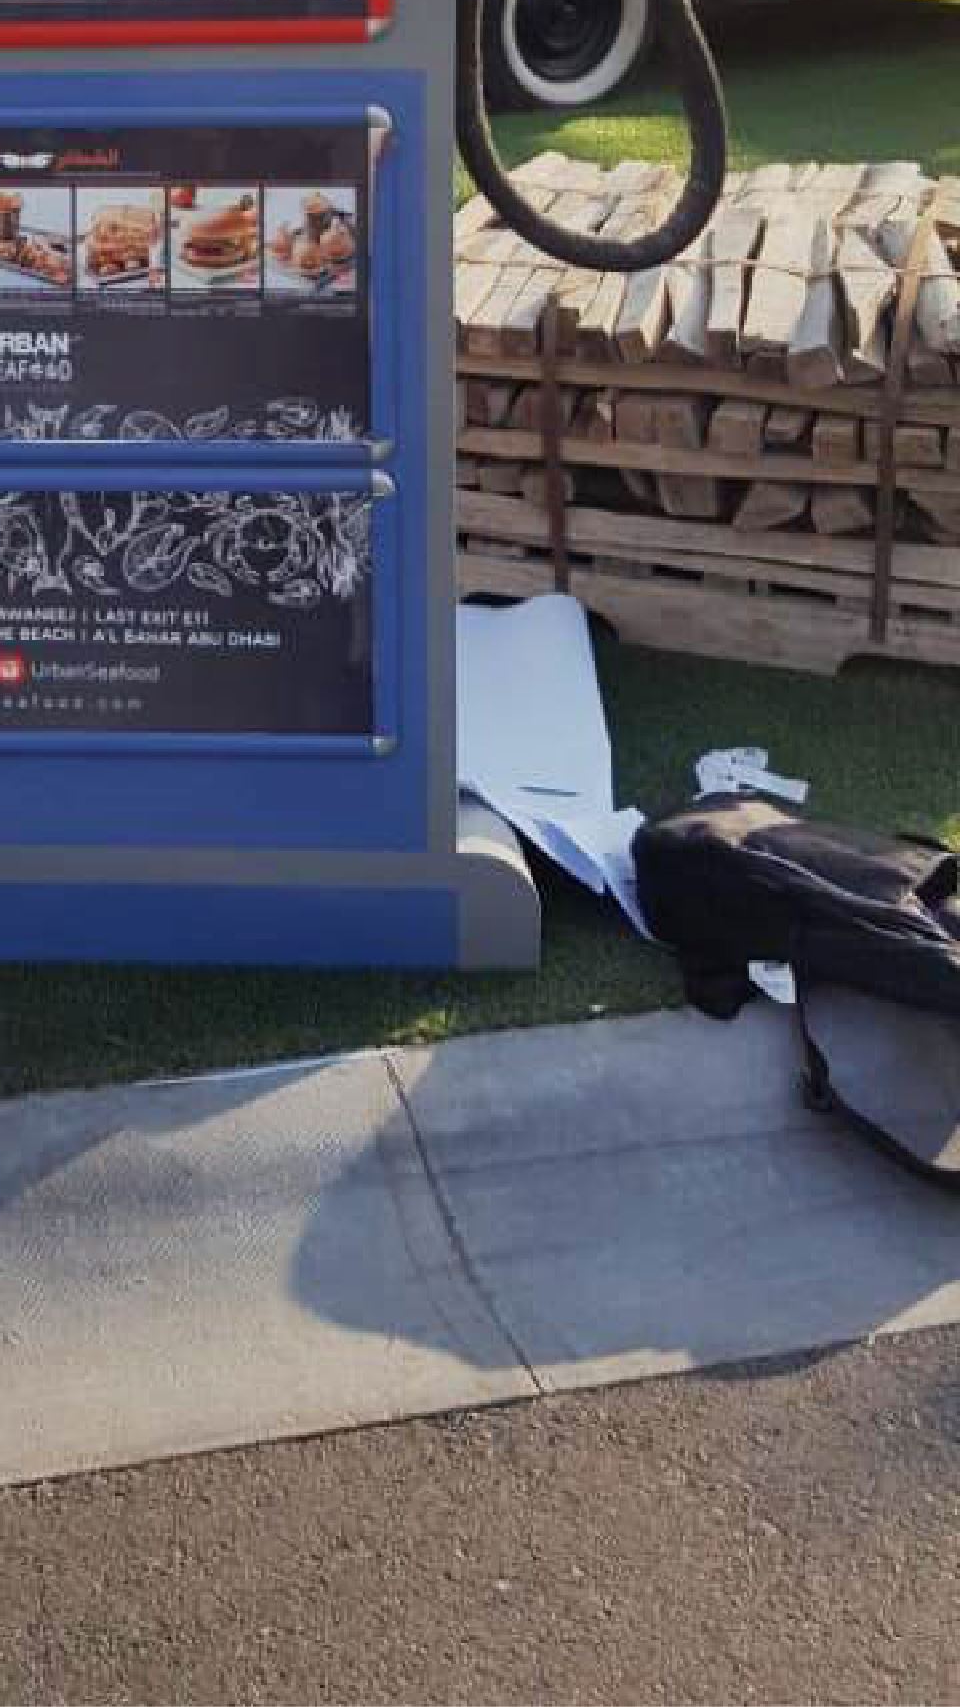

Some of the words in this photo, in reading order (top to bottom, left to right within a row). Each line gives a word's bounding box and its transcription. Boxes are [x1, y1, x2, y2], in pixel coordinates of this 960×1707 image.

[95, 607, 135, 624] LAST
[141, 609, 178, 625] EXIT
[20, 626, 76, 642] BEACH
[188, 631, 225, 646] ABU
[227, 631, 281, 647] DHABI
[31, 660, 161, 684] UrbanSeafood
